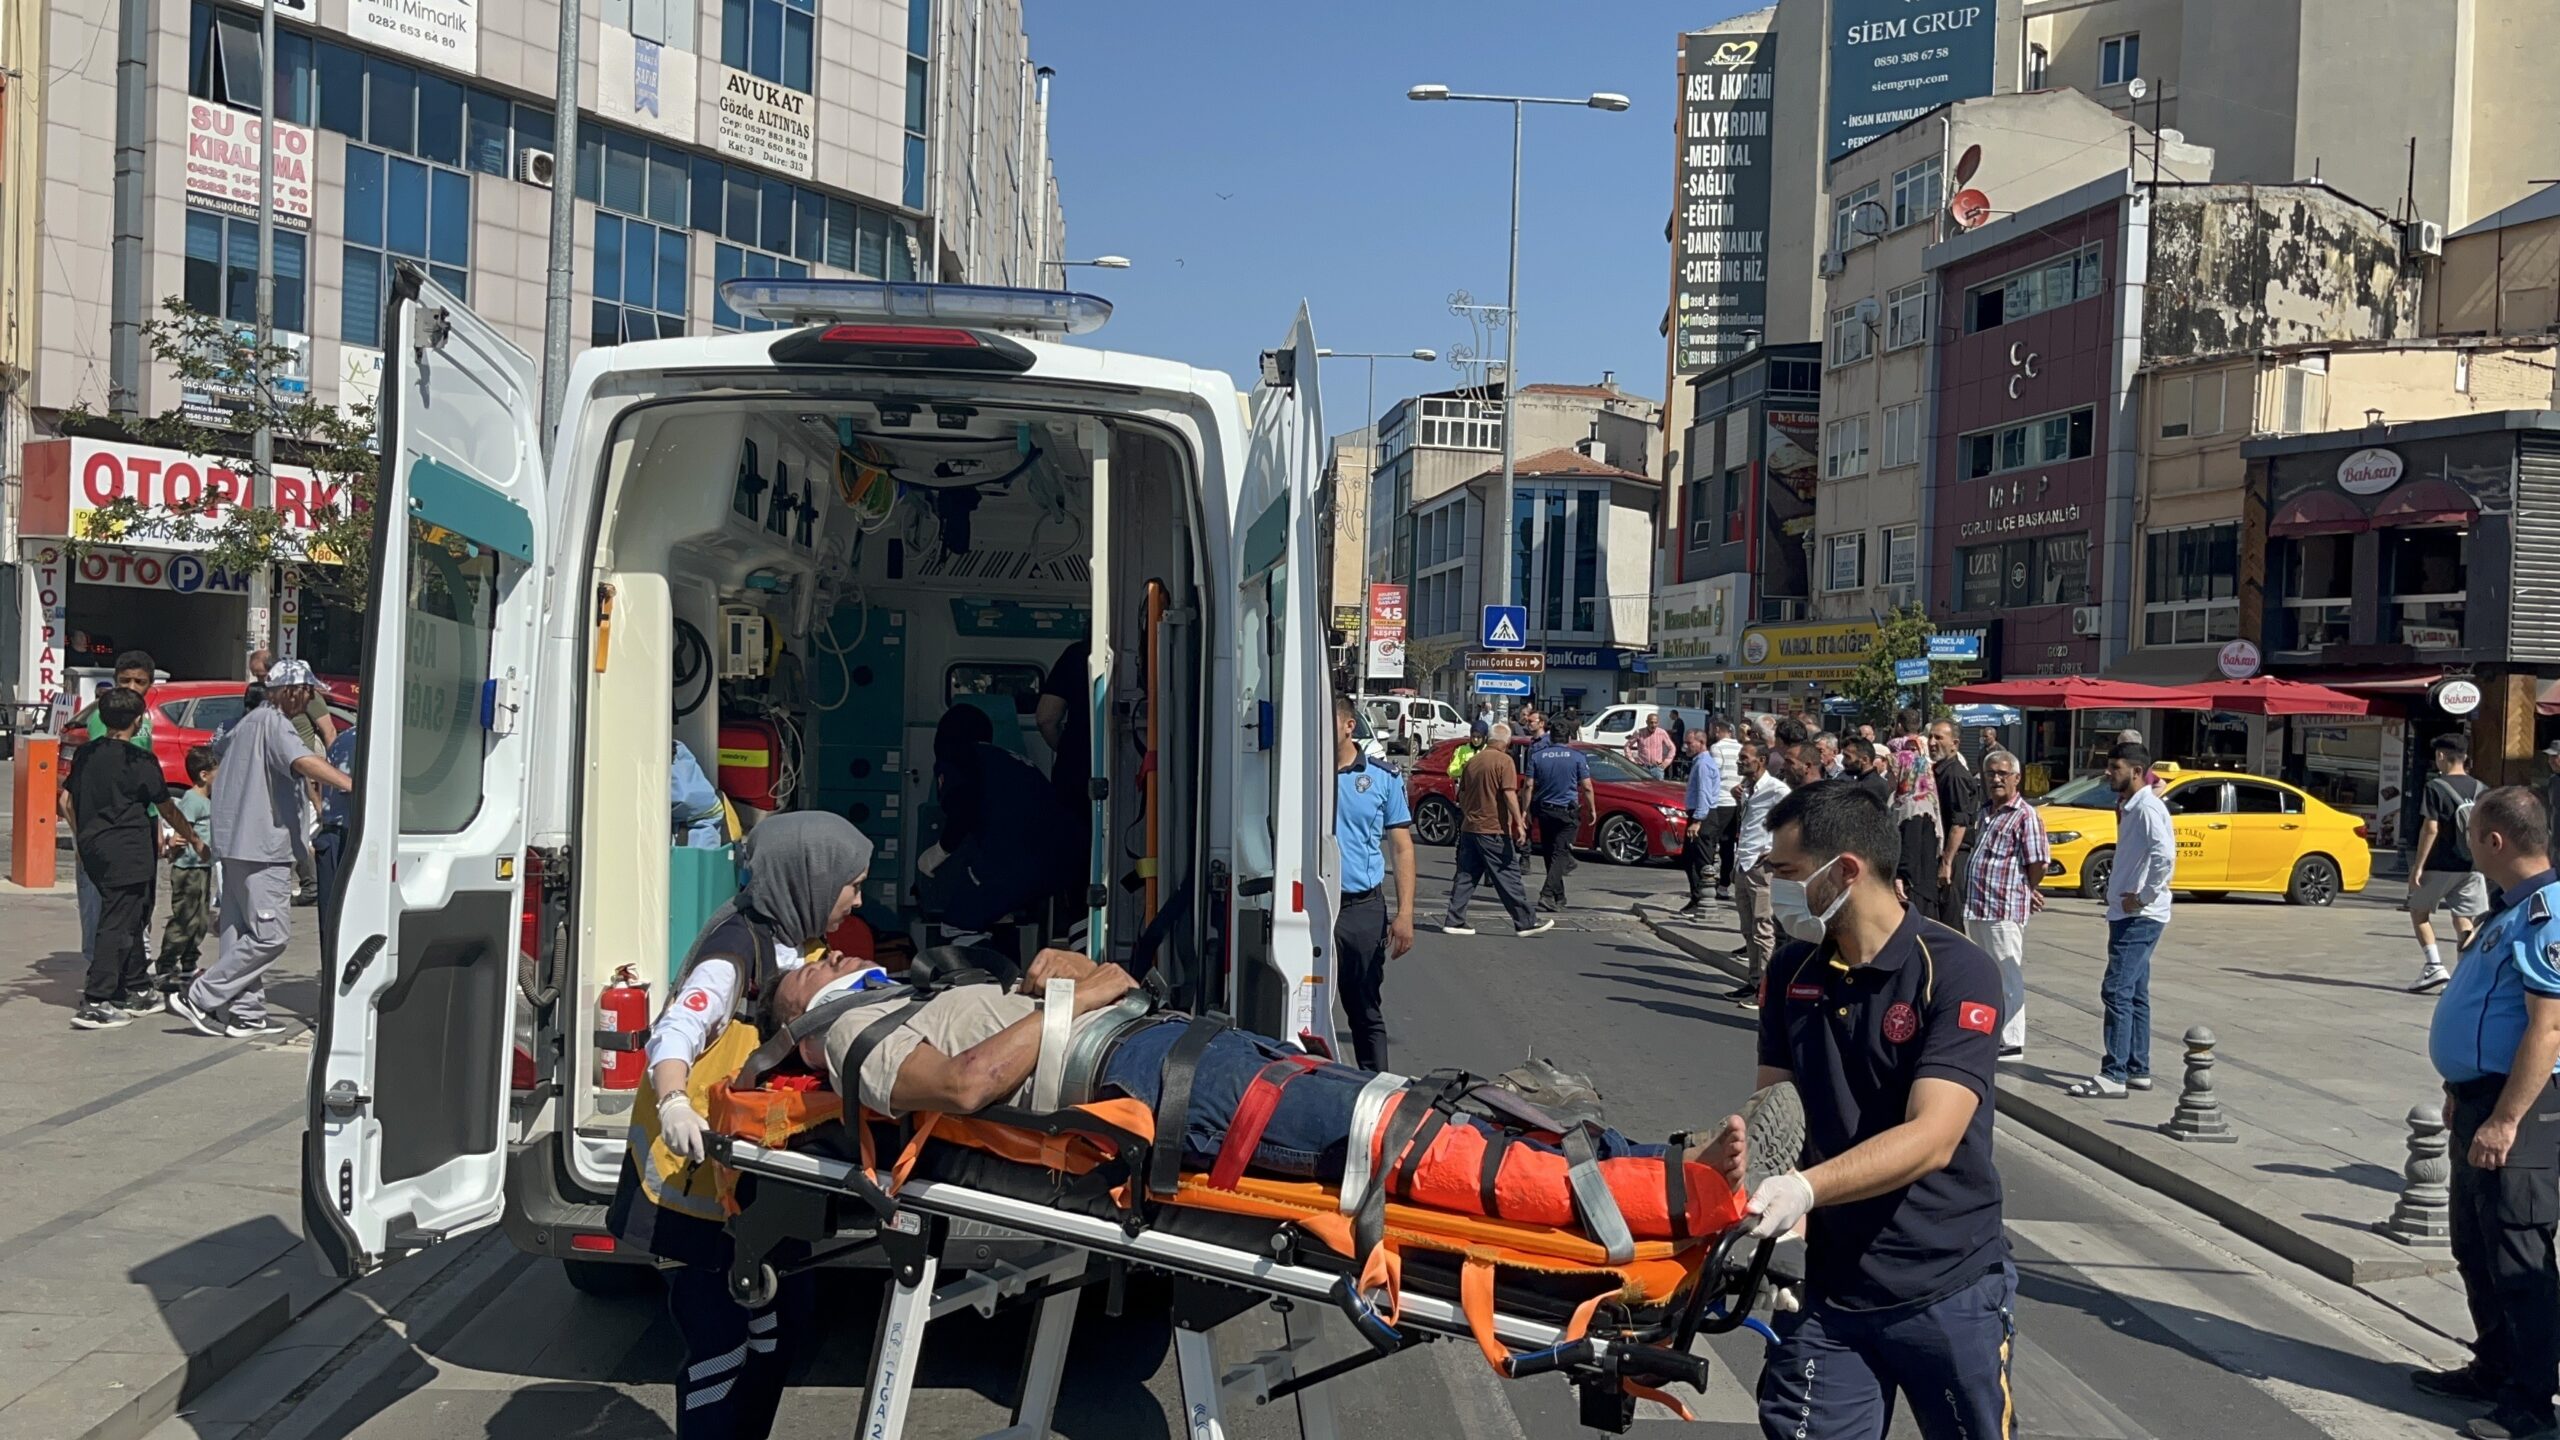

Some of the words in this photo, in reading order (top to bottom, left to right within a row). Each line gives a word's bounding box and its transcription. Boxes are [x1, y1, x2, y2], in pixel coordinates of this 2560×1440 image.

[368, 13, 397, 31] 0282
[400, 20, 421, 38] 653
[424, 31, 438, 44] 64
[441, 36, 456, 49] 80
[1847, 18, 1907, 45] SİEM
[1913, 6, 1980, 35] GRUP
[1874, 55, 1899, 67] 0850
[1900, 52, 1919, 64] 308
[1921, 49, 1934, 61] 67
[1936, 47, 1949, 59] 58
[726, 73, 805, 115] AVUKAT
[1686, 74, 1714, 101] ASEL
[1719, 66, 1772, 101] AKADEMİ
[1871, 73, 1949, 92] siemgrup.com
[190, 105, 235, 137] SU
[720, 96, 754, 120] Gözde
[757, 109, 810, 140] ALTINTAŞ
[722, 116, 743, 129] Cep:
[744, 123, 767, 135] 0537
[785, 136, 796, 146] 88
[798, 141, 806, 150] 31
[1687, 105, 1711, 138] İLK
[1713, 110, 1767, 137] YARDIM
[1848, 113, 1876, 128] İNSAN
[189, 132, 306, 184] KIRALMA
[719, 126, 742, 139] Ofis:
[744, 133, 765, 147] 0282
[767, 141, 783, 153] 650
[785, 147, 796, 157] 56
[797, 152, 808, 161] 08
[728, 140, 746, 153] Kat:
[747, 146, 754, 156] 3
[763, 151, 788, 167] Daire:
[789, 160, 804, 172] 313
[1743, 254, 1765, 283] HİZ.
[1689, 293, 1739, 311] asel_akademi
[1961, 519, 1992, 539] ÇORLU
[1546, 650, 1597, 667] apıKredi
[1778, 636, 1813, 656] VAROL
[1466, 658, 1489, 667] Tarihi
[1490, 658, 1513, 668] Çorlu
[1515, 658, 1528, 667] Evi
